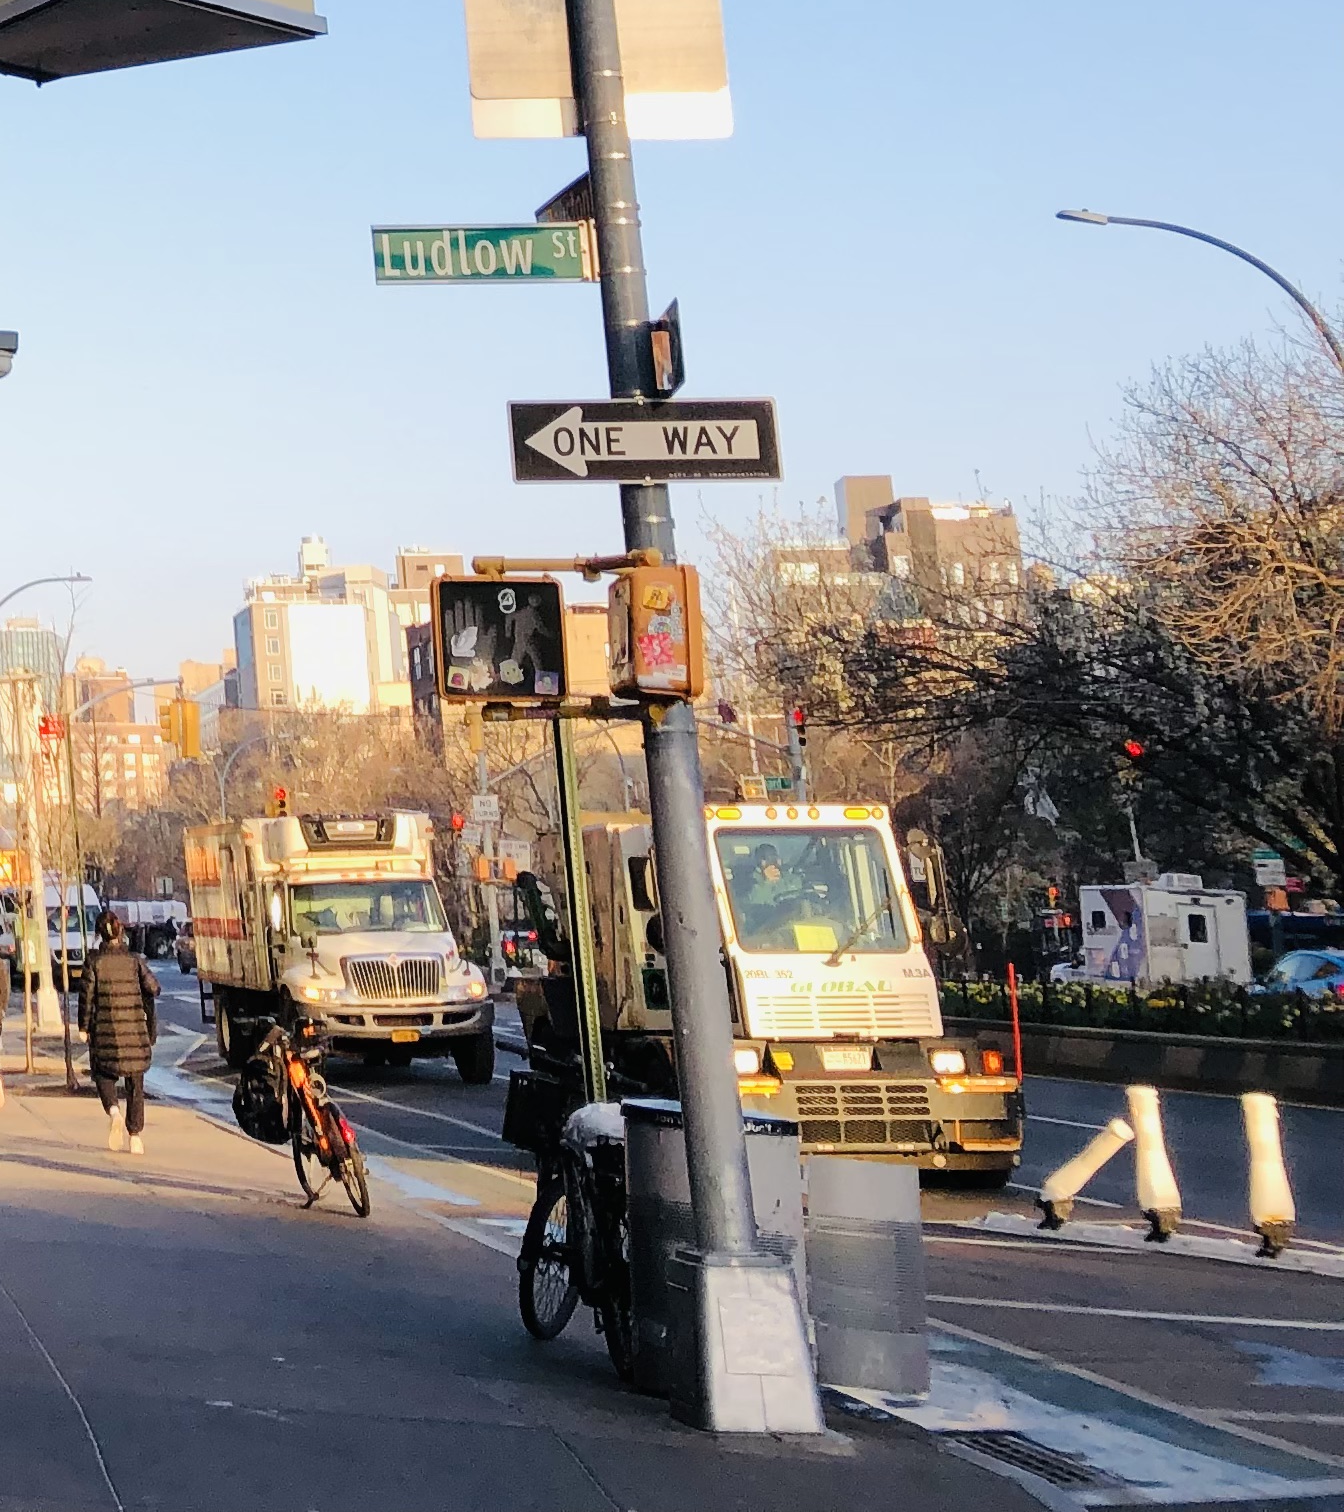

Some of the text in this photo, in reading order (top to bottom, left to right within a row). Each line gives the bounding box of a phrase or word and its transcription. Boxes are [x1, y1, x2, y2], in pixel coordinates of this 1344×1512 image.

[381, 230, 578, 276] Ludlow St
[553, 425, 740, 456] ONE WAY
